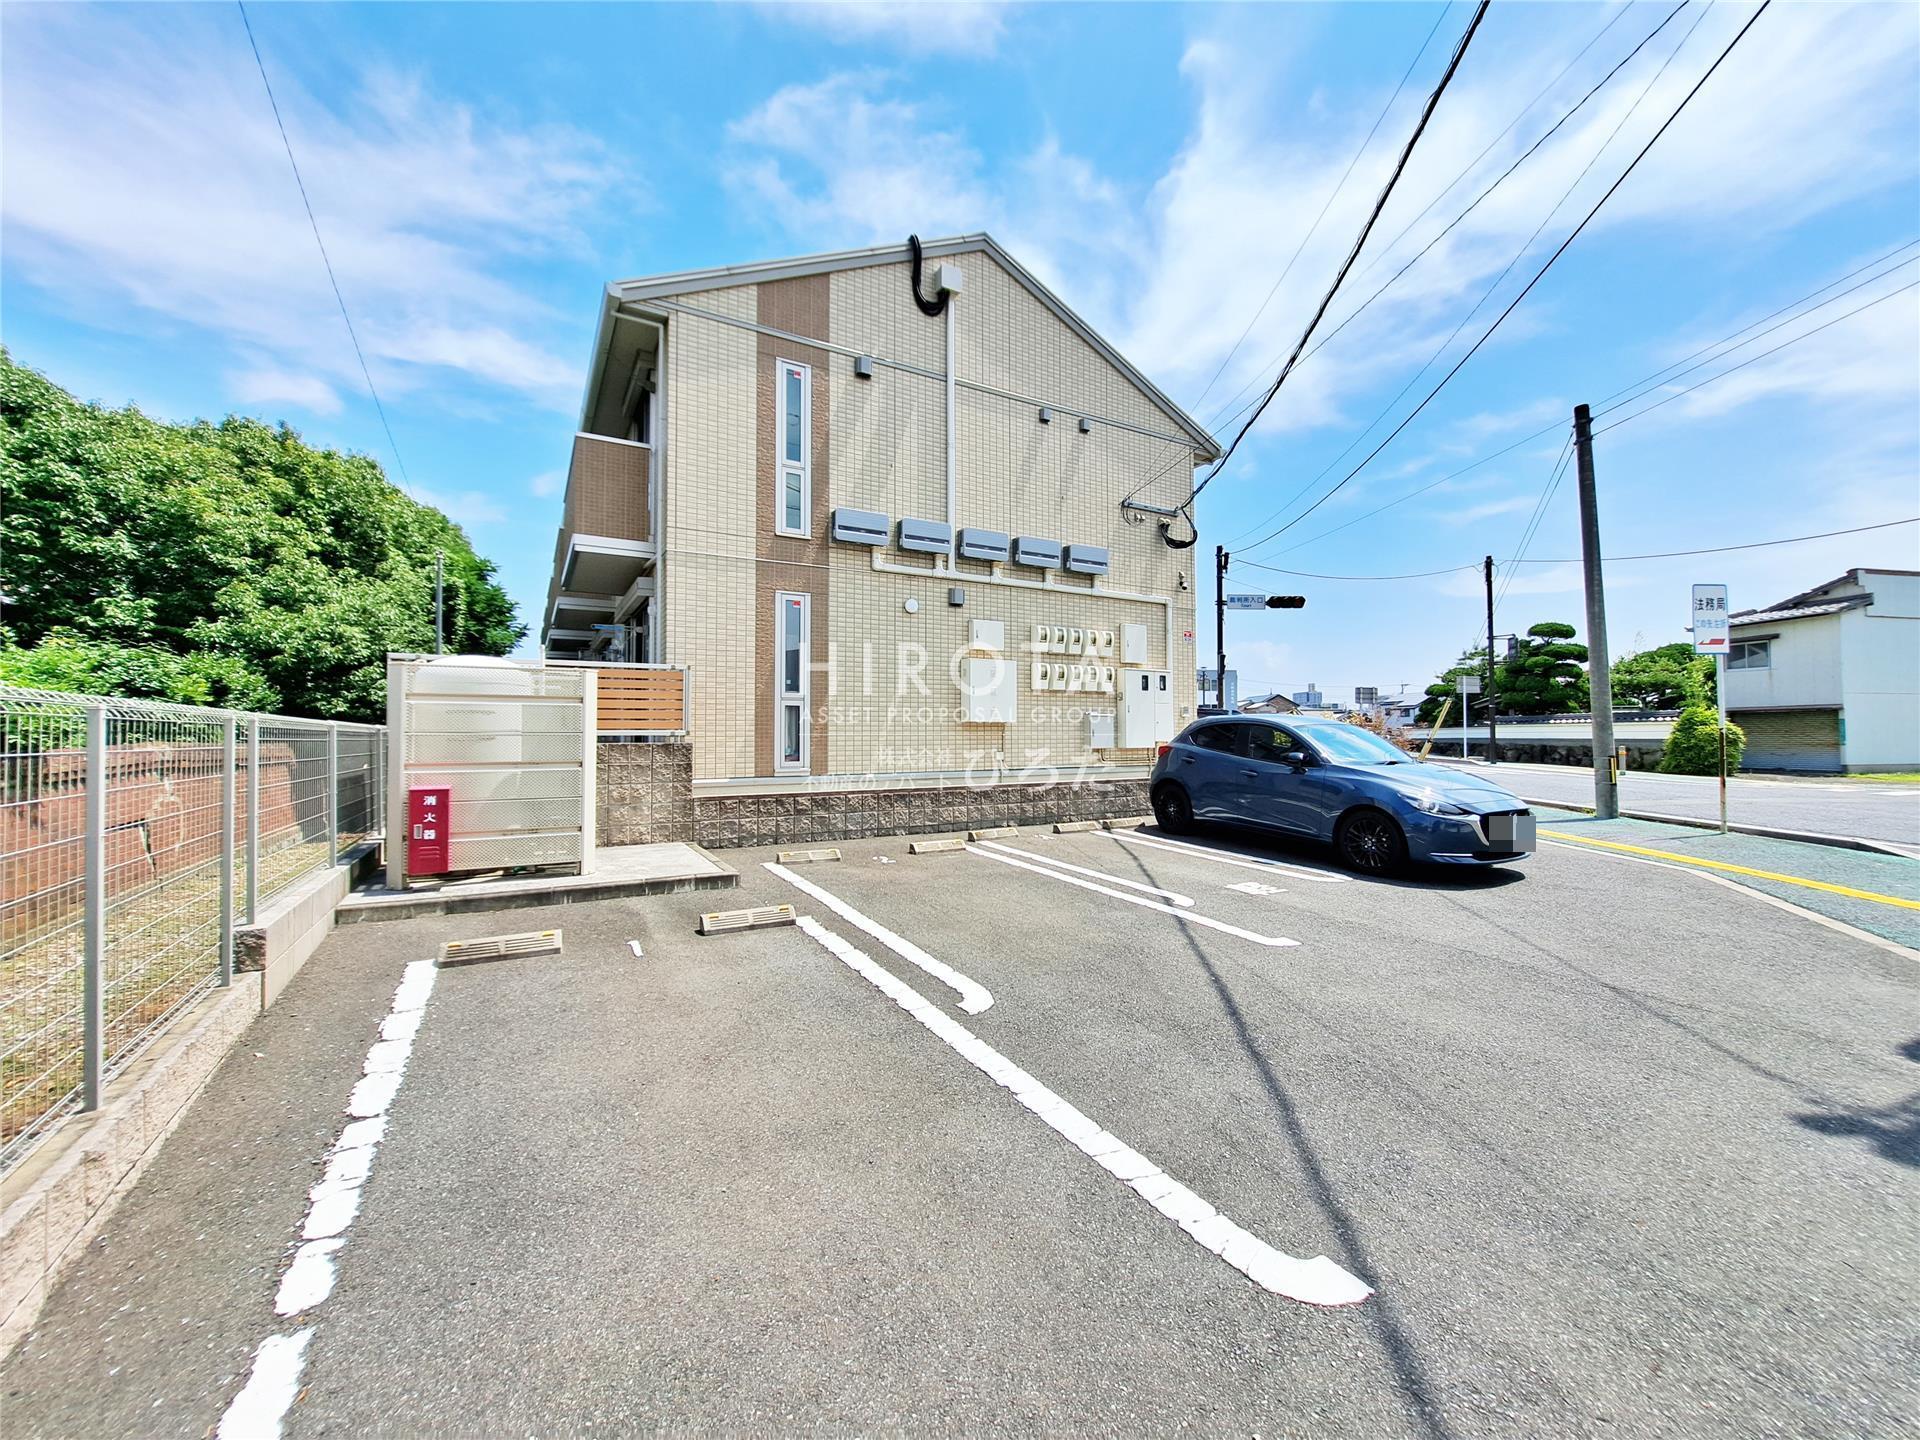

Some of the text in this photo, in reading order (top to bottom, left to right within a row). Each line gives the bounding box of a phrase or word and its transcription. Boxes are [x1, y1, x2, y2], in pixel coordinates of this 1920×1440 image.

[1694, 597, 1726, 611] 法務局
[422, 795, 437, 840] 消火器
[624, 939, 645, 957] 1
